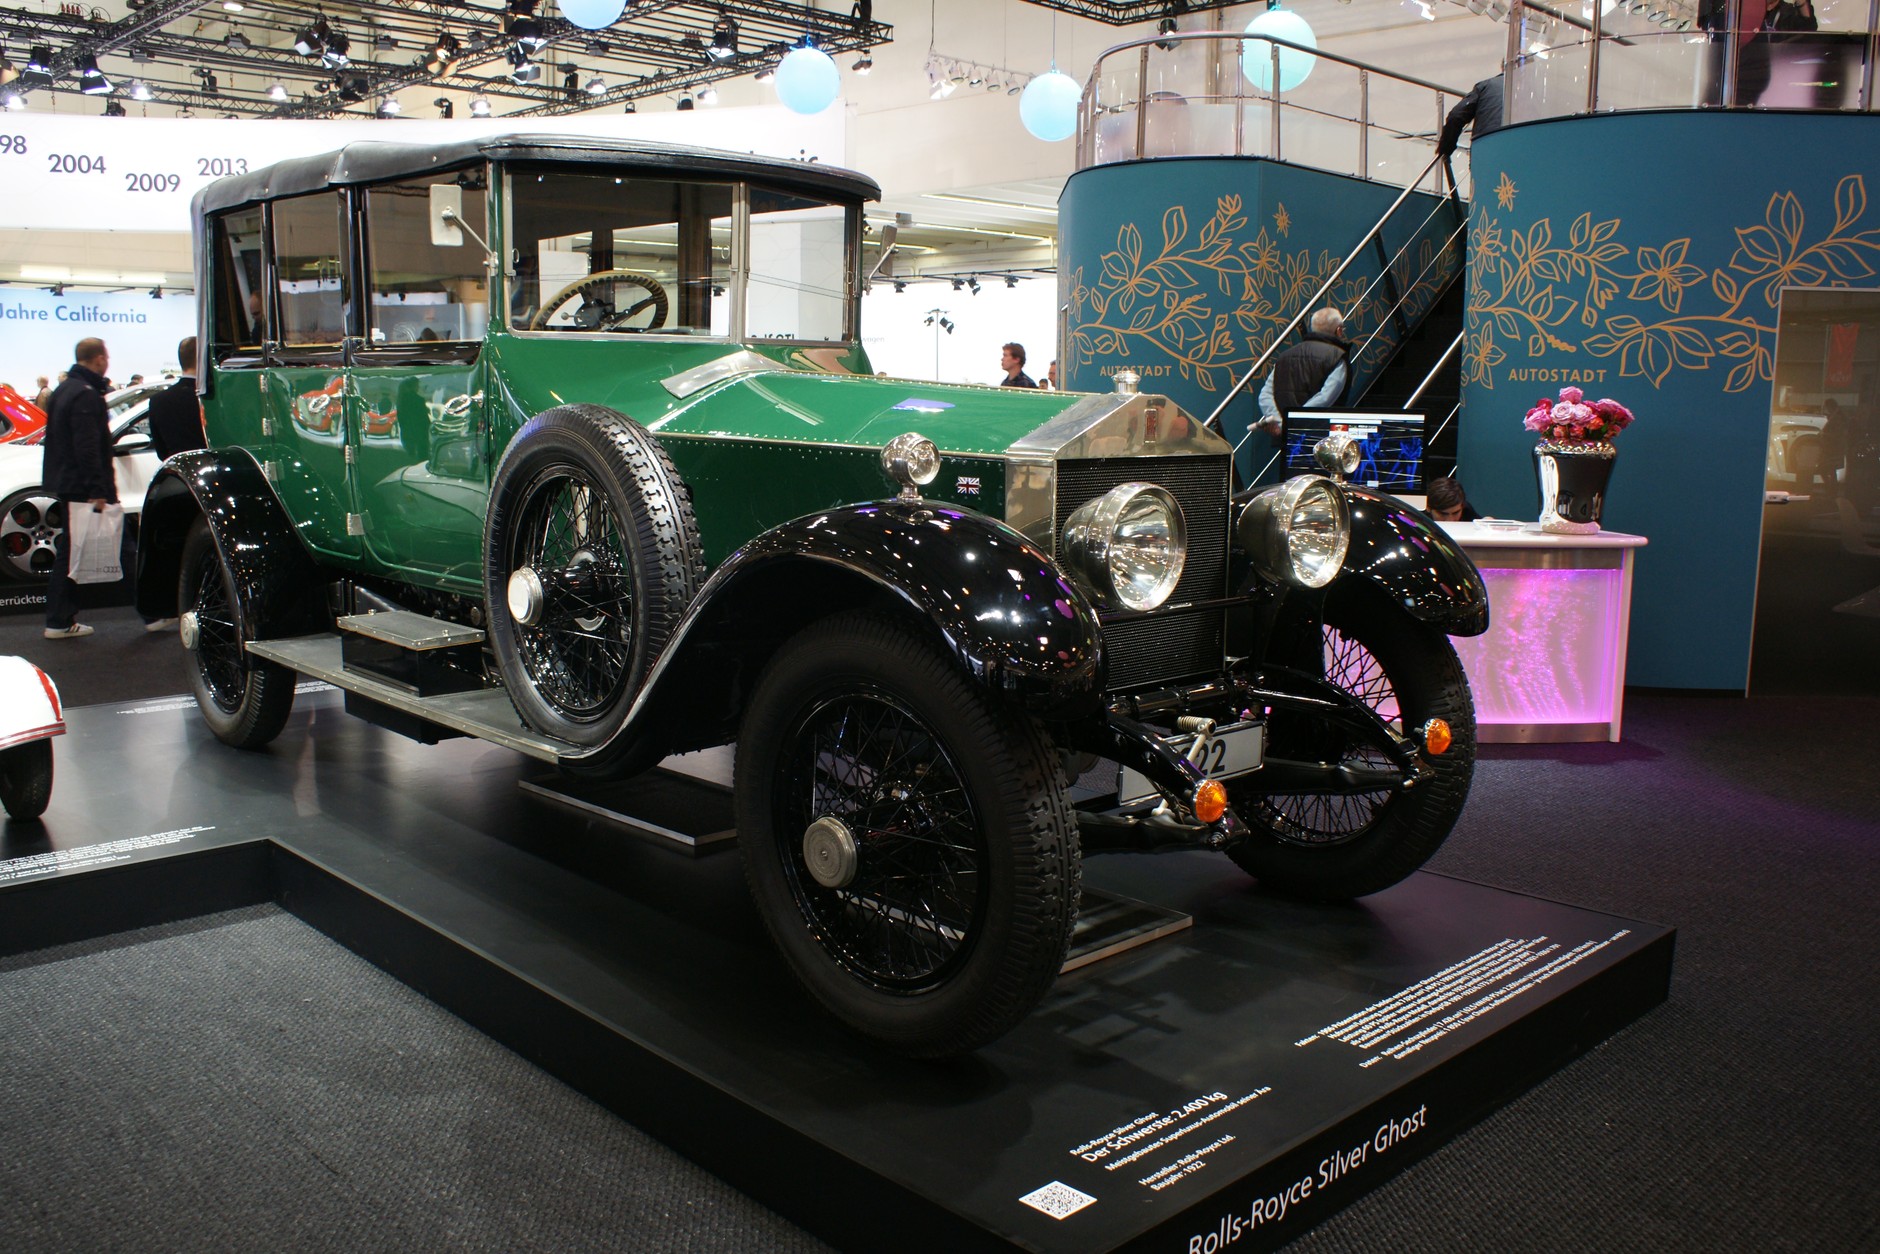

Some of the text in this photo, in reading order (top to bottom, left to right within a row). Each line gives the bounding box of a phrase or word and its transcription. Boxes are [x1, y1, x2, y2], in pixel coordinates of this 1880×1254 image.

[48, 153, 106, 174] 2004
[197, 157, 248, 177] 2013
[125, 173, 181, 193] 2009
[0, 302, 147, 323] Jahre California
[1508, 368, 1607, 383] AUTOSTADT
[0, 594, 47, 607] errücktes
[1069, 1111, 1159, 1156] Rolls-Royce Silver Ghost
[1081, 1091, 1228, 1162] Der Schwerste: 2.400 kg
[1104, 1141, 1163, 1171] Meistgebautes
[1138, 1134, 1236, 1186] Hersteller: Rolls-Royce Ltd.
[1150, 1160, 1206, 1191] Baujahr: 1922
[1188, 1103, 1427, 1254] Rolls-Royce Silver Ghost
